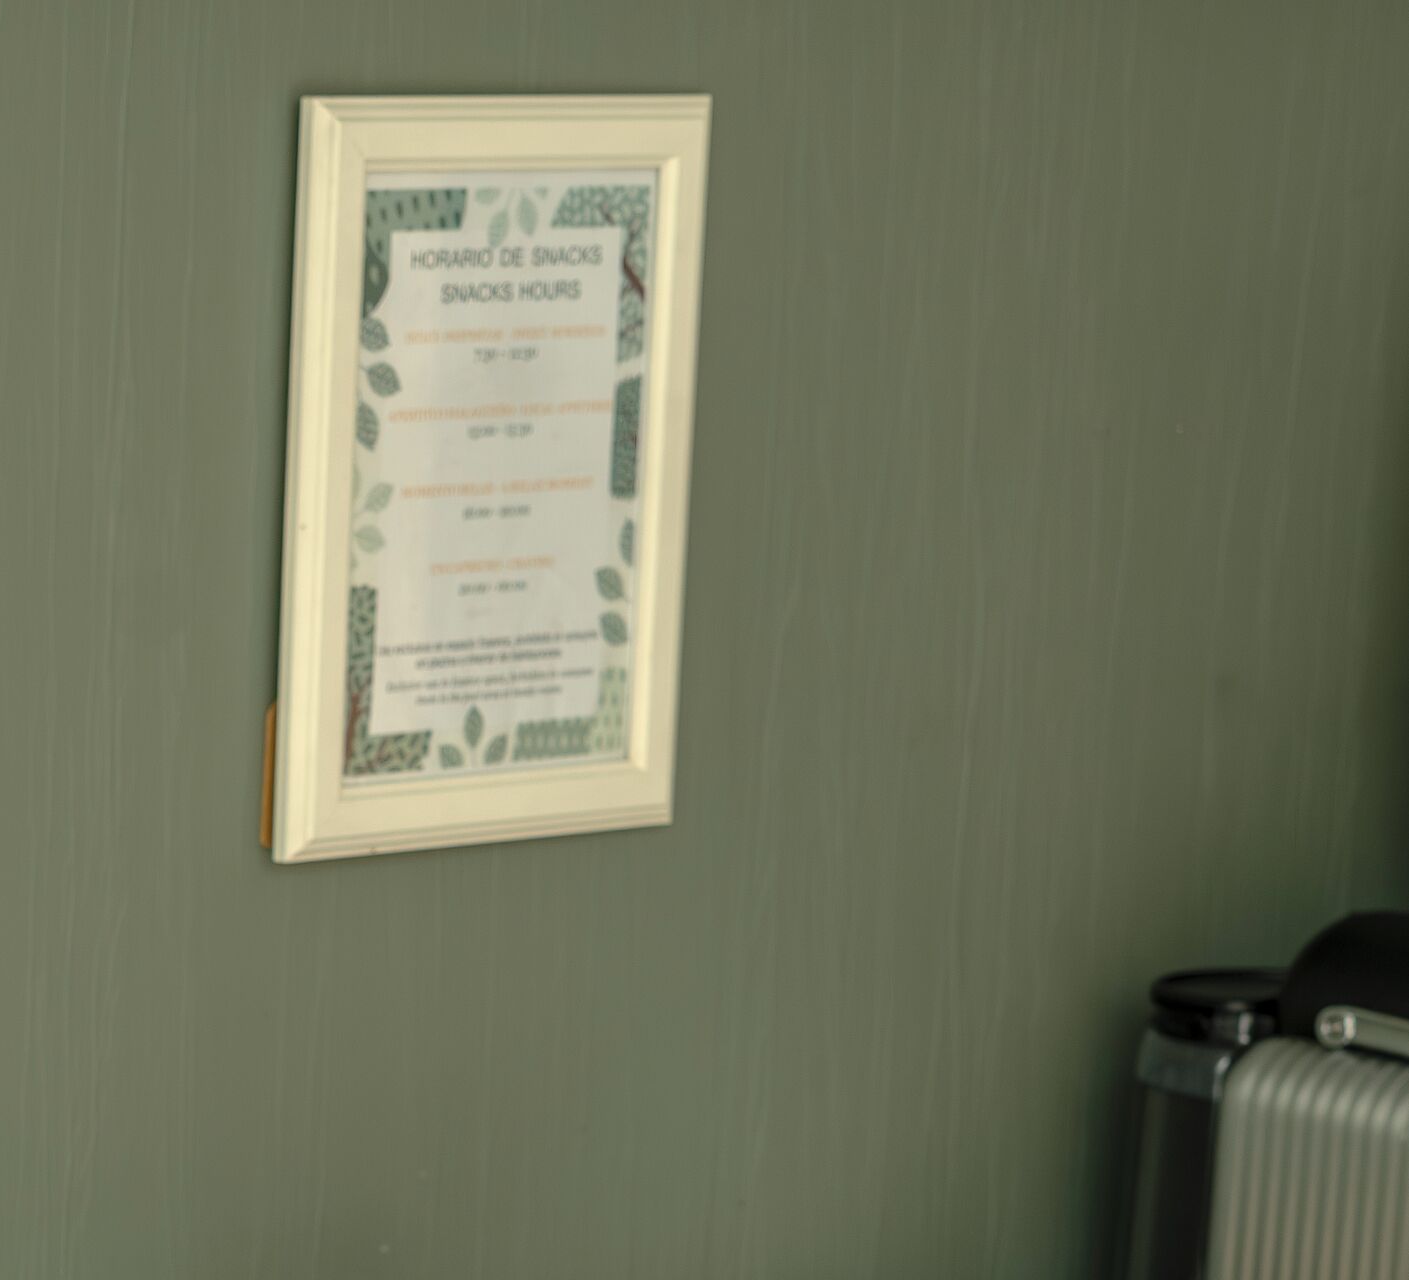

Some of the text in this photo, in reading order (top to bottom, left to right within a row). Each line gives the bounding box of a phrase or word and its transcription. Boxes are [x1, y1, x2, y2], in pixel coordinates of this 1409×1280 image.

[410, 244, 603, 270] HORARIO DE SNACKS
[441, 278, 582, 304] SNACKS HOURS
